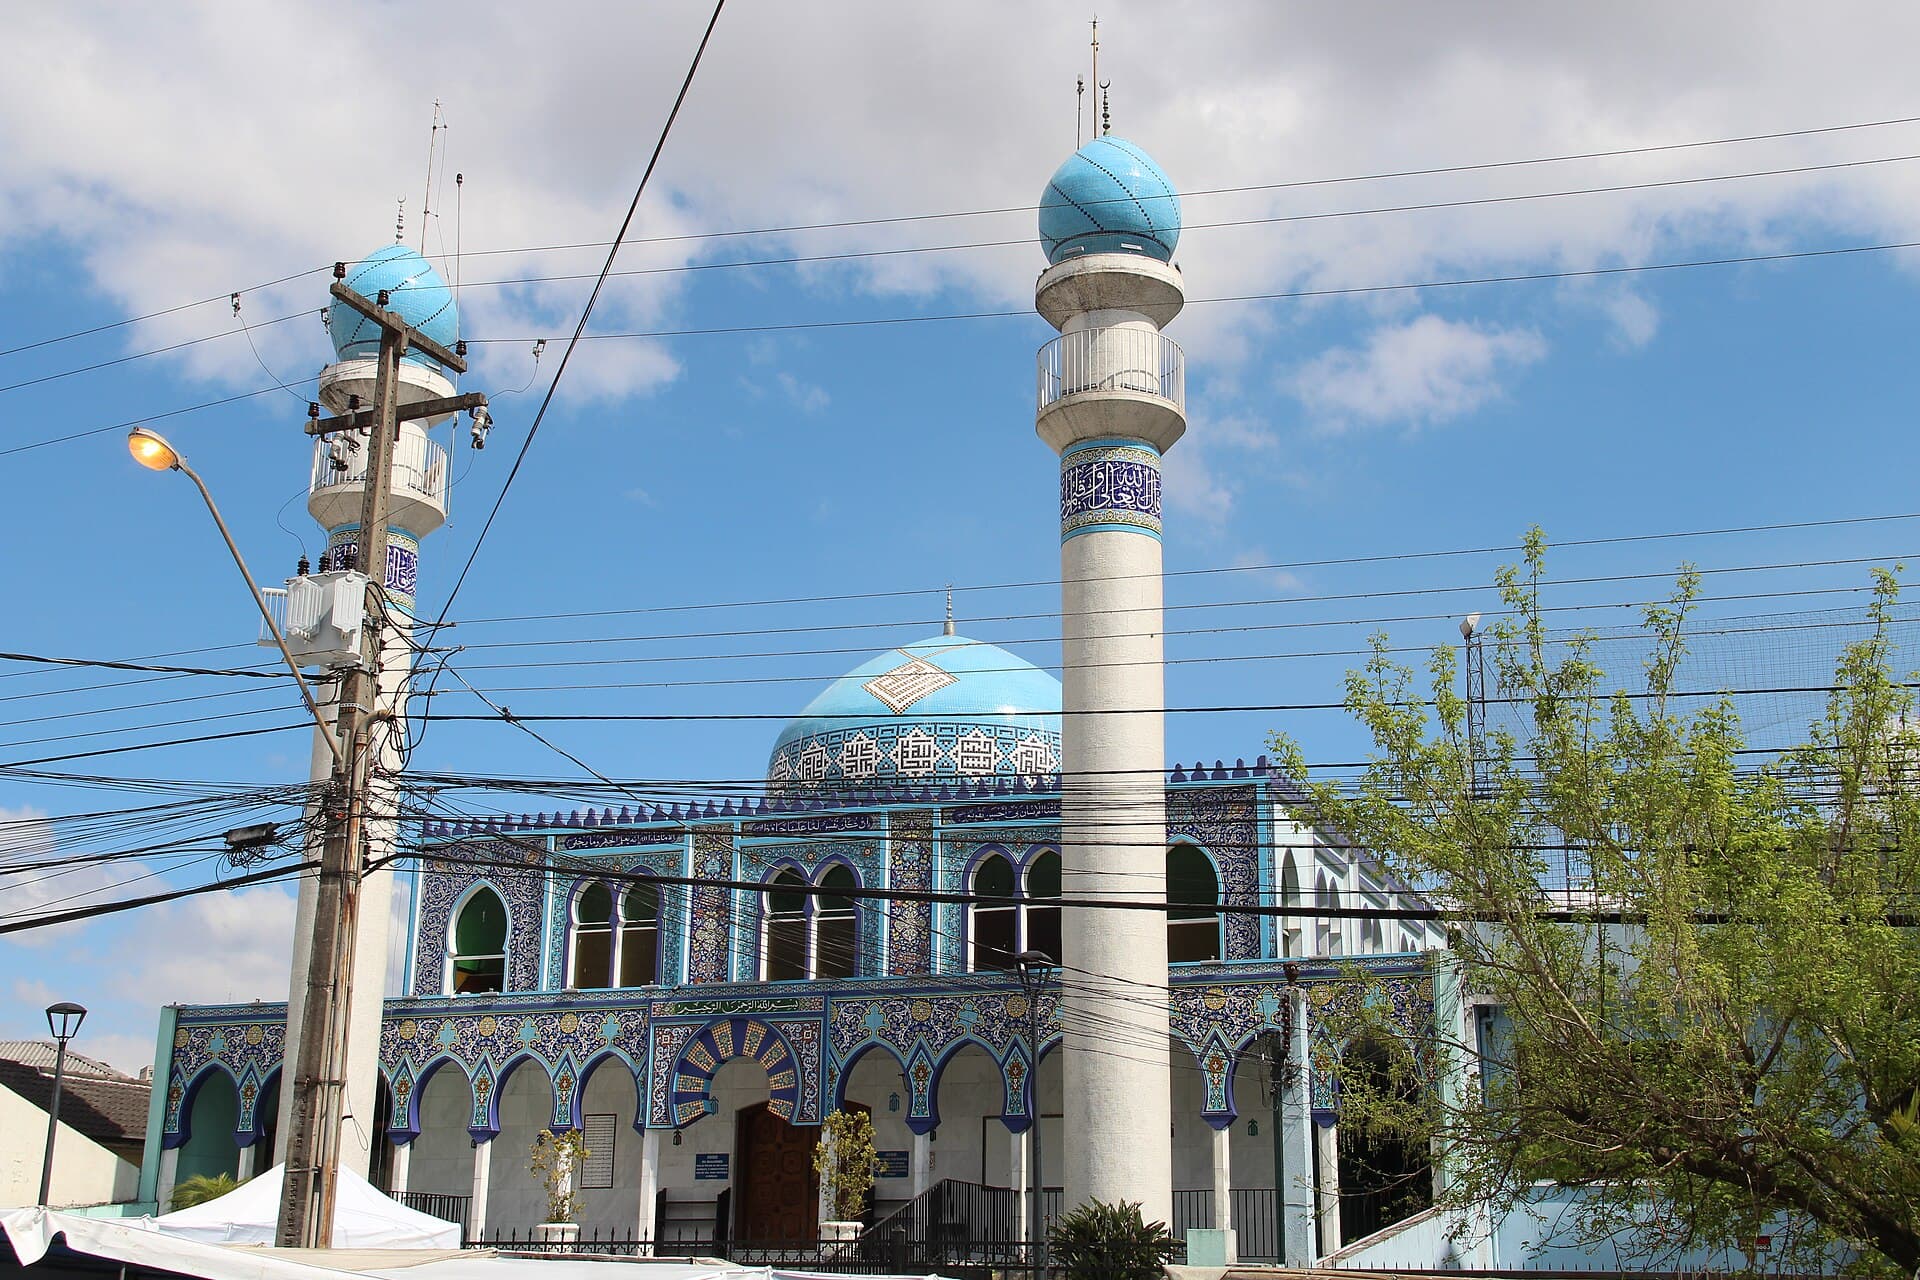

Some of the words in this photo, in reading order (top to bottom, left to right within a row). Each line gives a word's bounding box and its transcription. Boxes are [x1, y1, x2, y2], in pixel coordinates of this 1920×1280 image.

[677, 1000, 722, 1015] الرحيم
[721, 999, 757, 1014] الرحمن
[756, 999, 770, 1009] الله
[766, 999, 799, 1012] بسم
